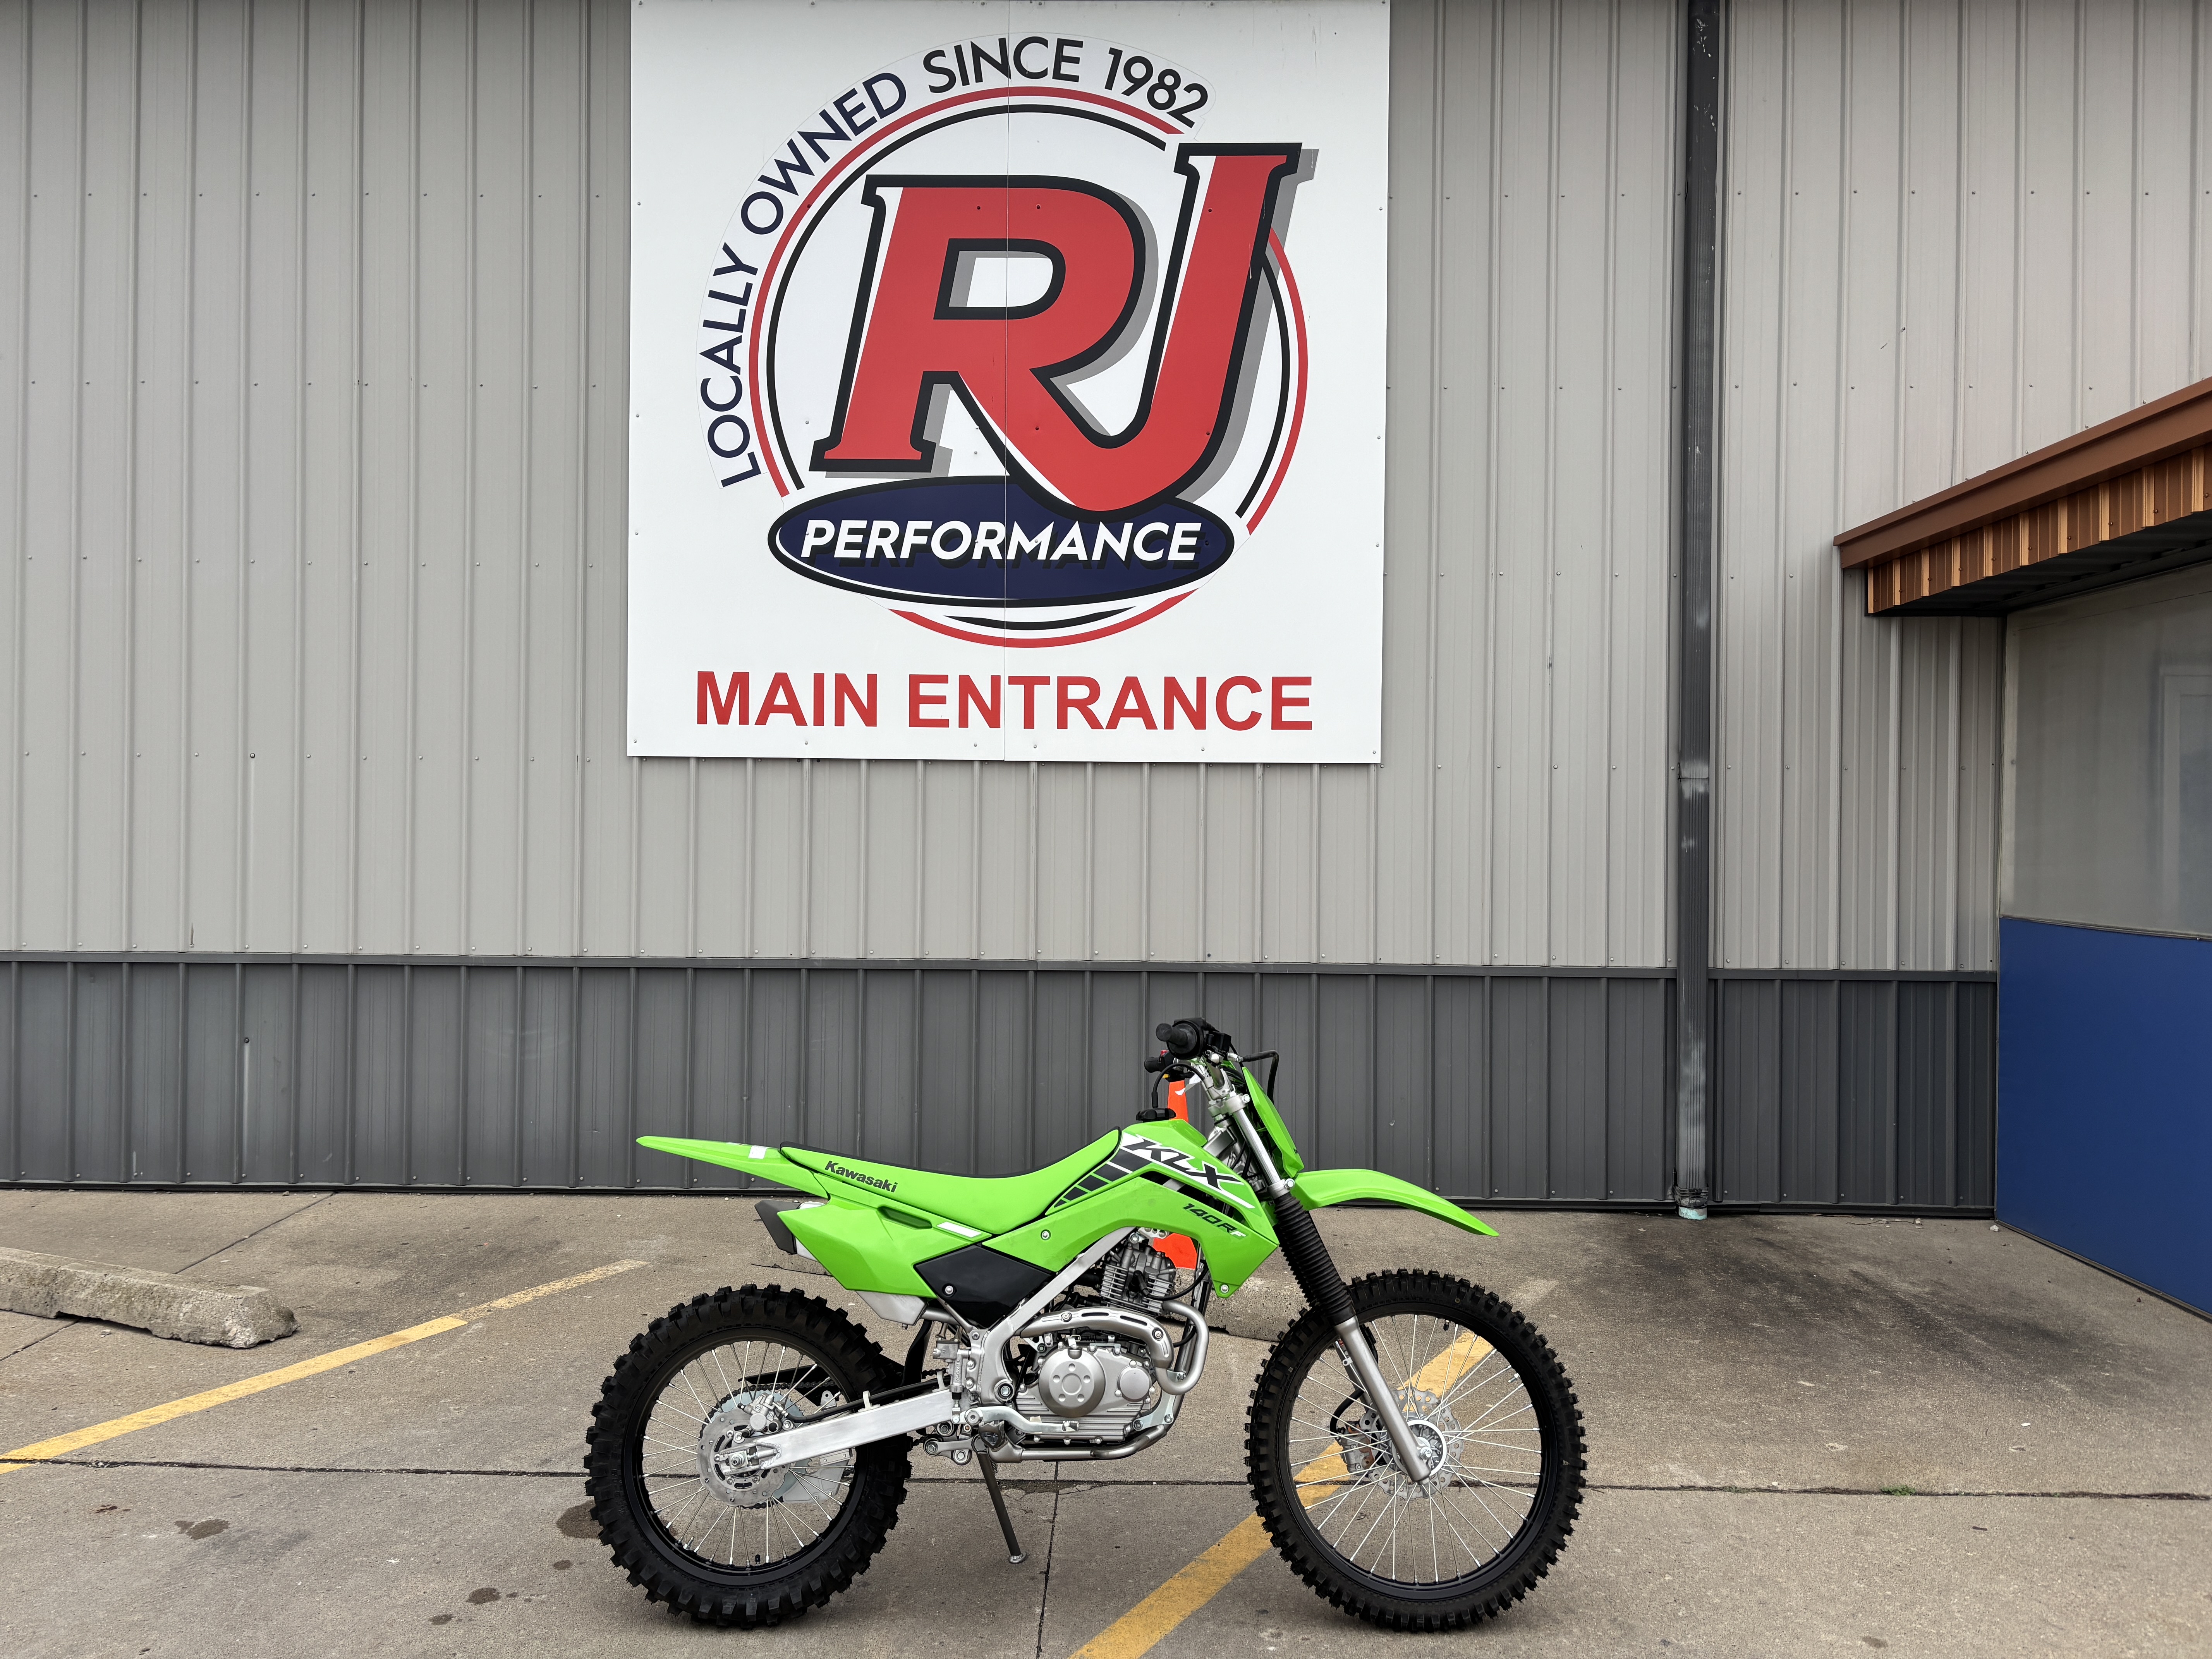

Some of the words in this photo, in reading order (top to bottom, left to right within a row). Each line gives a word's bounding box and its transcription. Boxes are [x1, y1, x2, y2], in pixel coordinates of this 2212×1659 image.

[699, 242, 762, 488] LOCALLY
[740, 72, 907, 235] OWNED
[923, 36, 1084, 93] SINCE
[1104, 47, 1208, 129] 1982
[809, 142, 1303, 521] RJ
[801, 520, 1202, 562] PERFORMANCE
[697, 671, 877, 727] MAIN
[908, 674, 1312, 731] ENTRANCE
[824, 1160, 898, 1193] Kawasaki
[1122, 1135, 1243, 1192] KLX
